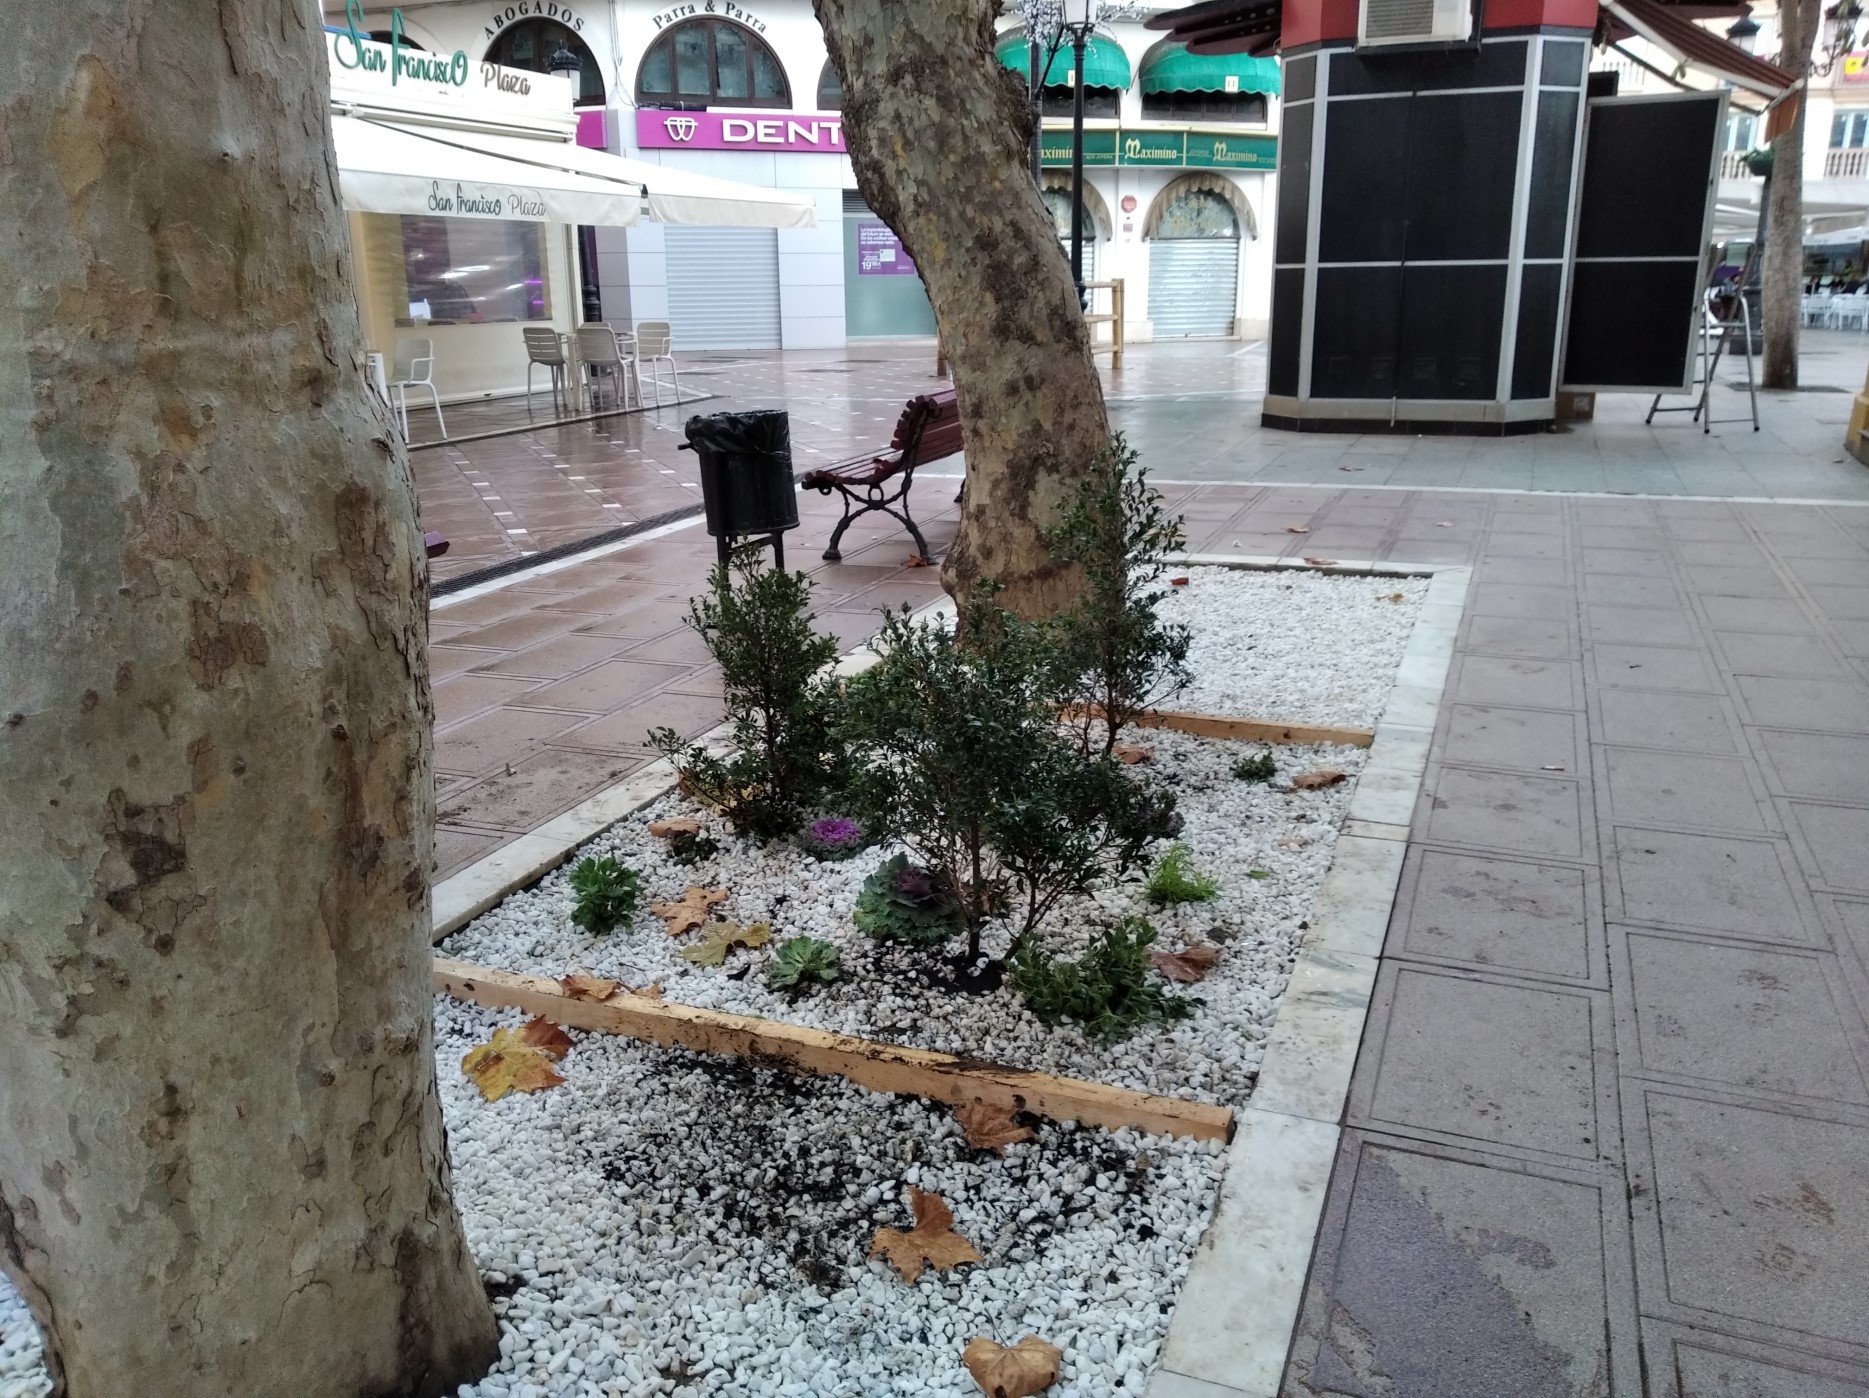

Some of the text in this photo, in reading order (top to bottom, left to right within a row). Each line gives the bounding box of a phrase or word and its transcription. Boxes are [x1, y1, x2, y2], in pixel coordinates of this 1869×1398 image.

[483, 0, 585, 41] ABOGADOS
[652, 0, 767, 34] Parra & Parra
[334, 0, 387, 73] San
[480, 61, 531, 96] Plaza
[1125, 137, 1178, 160] Maximino
[1213, 141, 1258, 163] Maximino
[428, 180, 546, 217] San Francisco Plaza
